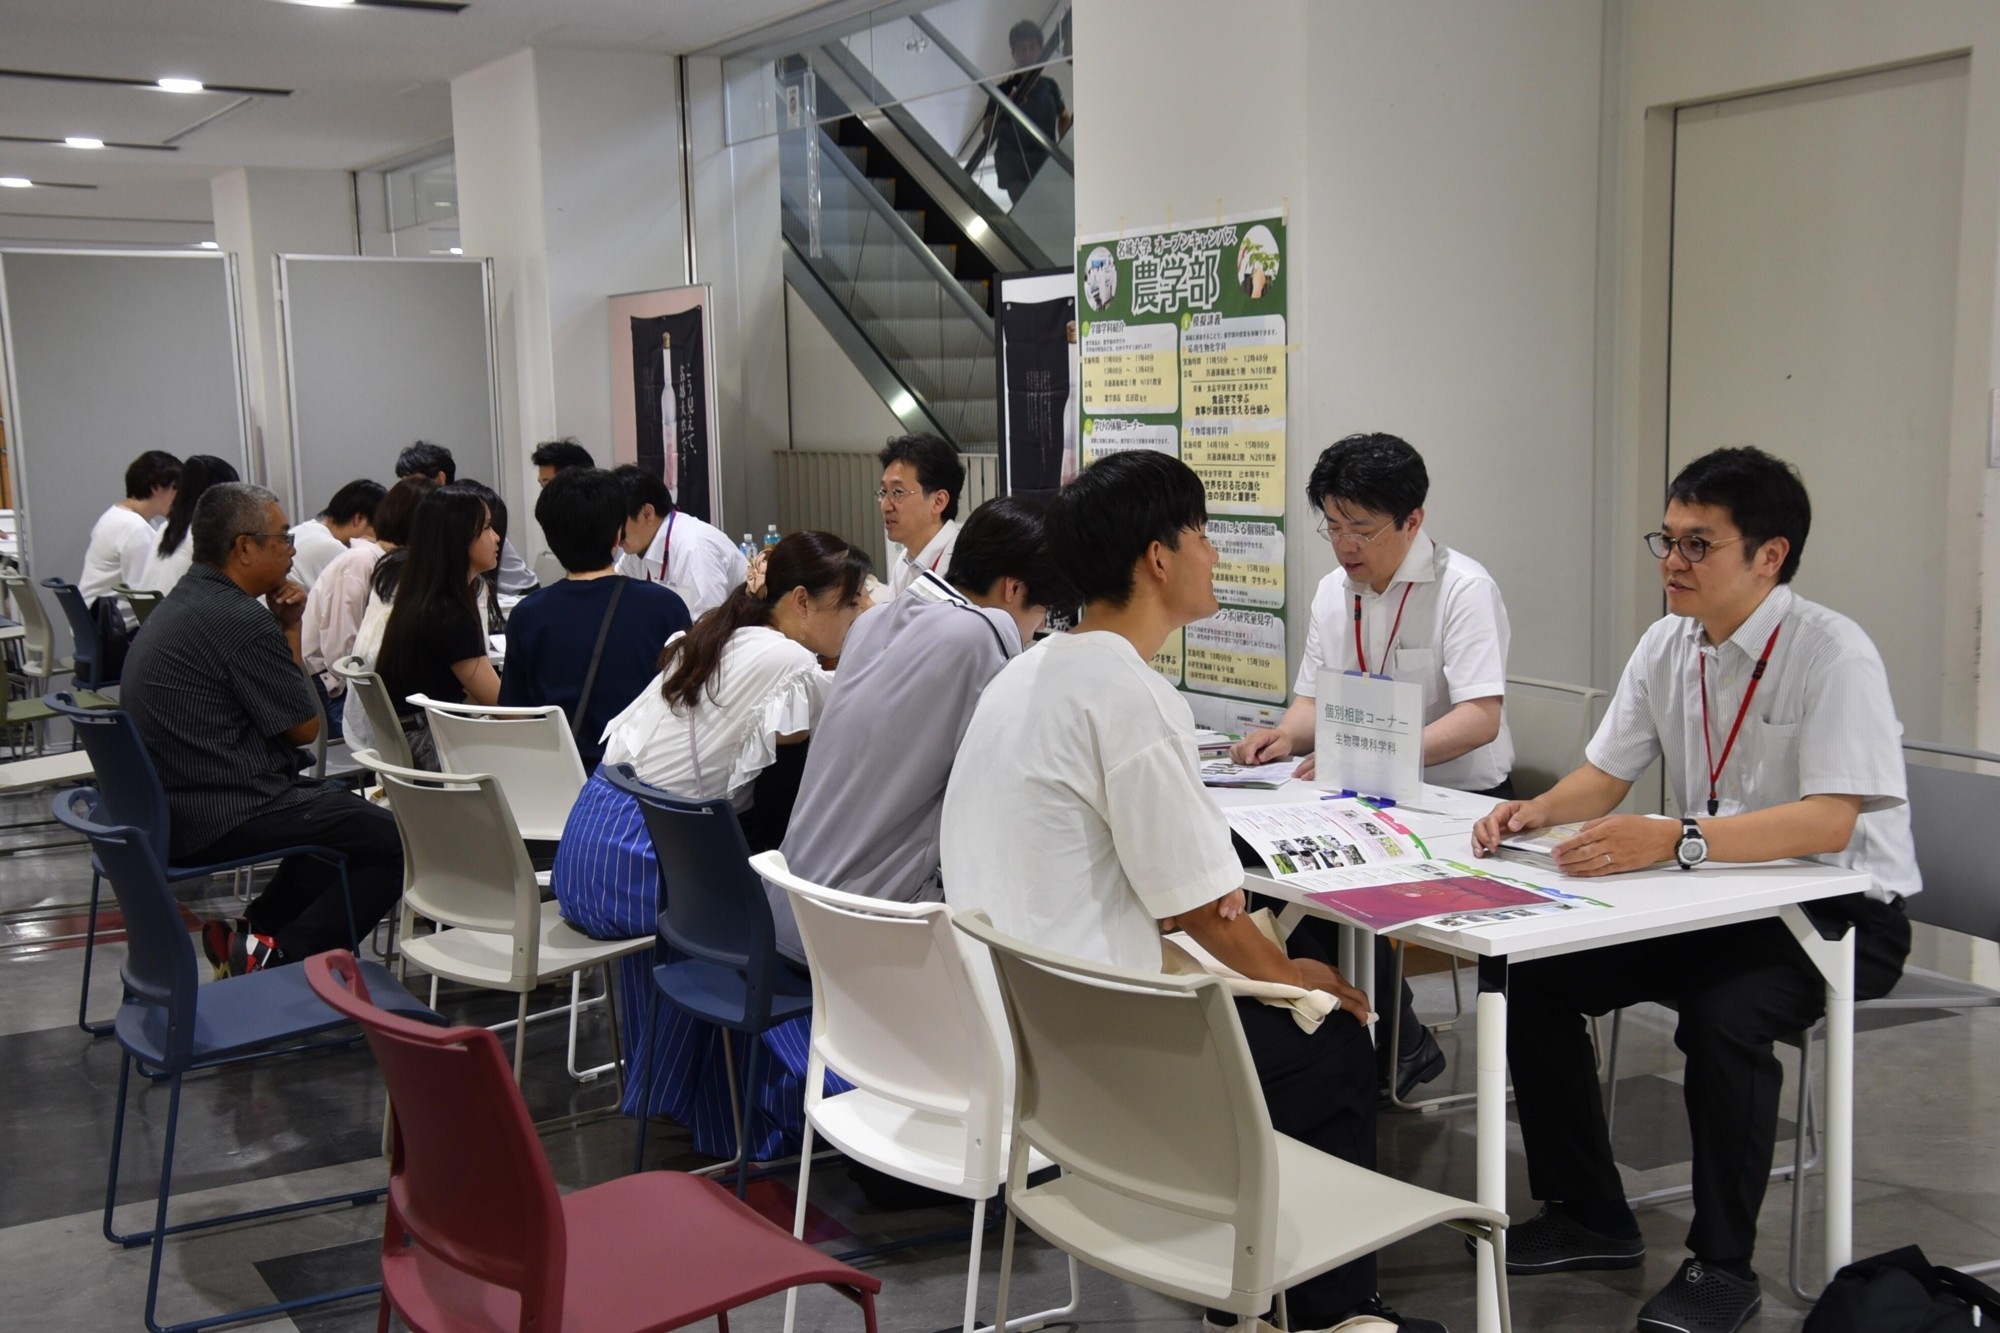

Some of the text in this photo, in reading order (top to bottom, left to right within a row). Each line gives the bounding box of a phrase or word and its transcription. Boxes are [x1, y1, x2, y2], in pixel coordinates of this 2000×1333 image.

[1118, 226, 1238, 259] 名城大学 オープンキャンパス
[1132, 251, 1221, 315] 農学部
[1192, 314, 1221, 327] 模擬講義
[1244, 354, 1268, 363] 12時40分
[1212, 394, 1249, 404] 食品学で学ぶ
[1195, 404, 1270, 416] 食事が健康を支える仕組み
[1093, 420, 1144, 432] 学びの体験コーナー
[1190, 426, 1228, 436] 生物環境科学科
[1206, 441, 1229, 449] 14時10分
[1245, 441, 1270, 449] 15時00分
[1325, 703, 1408, 728] 個別相談コーナー
[1336, 732, 1396, 756] 生物環境科学科
